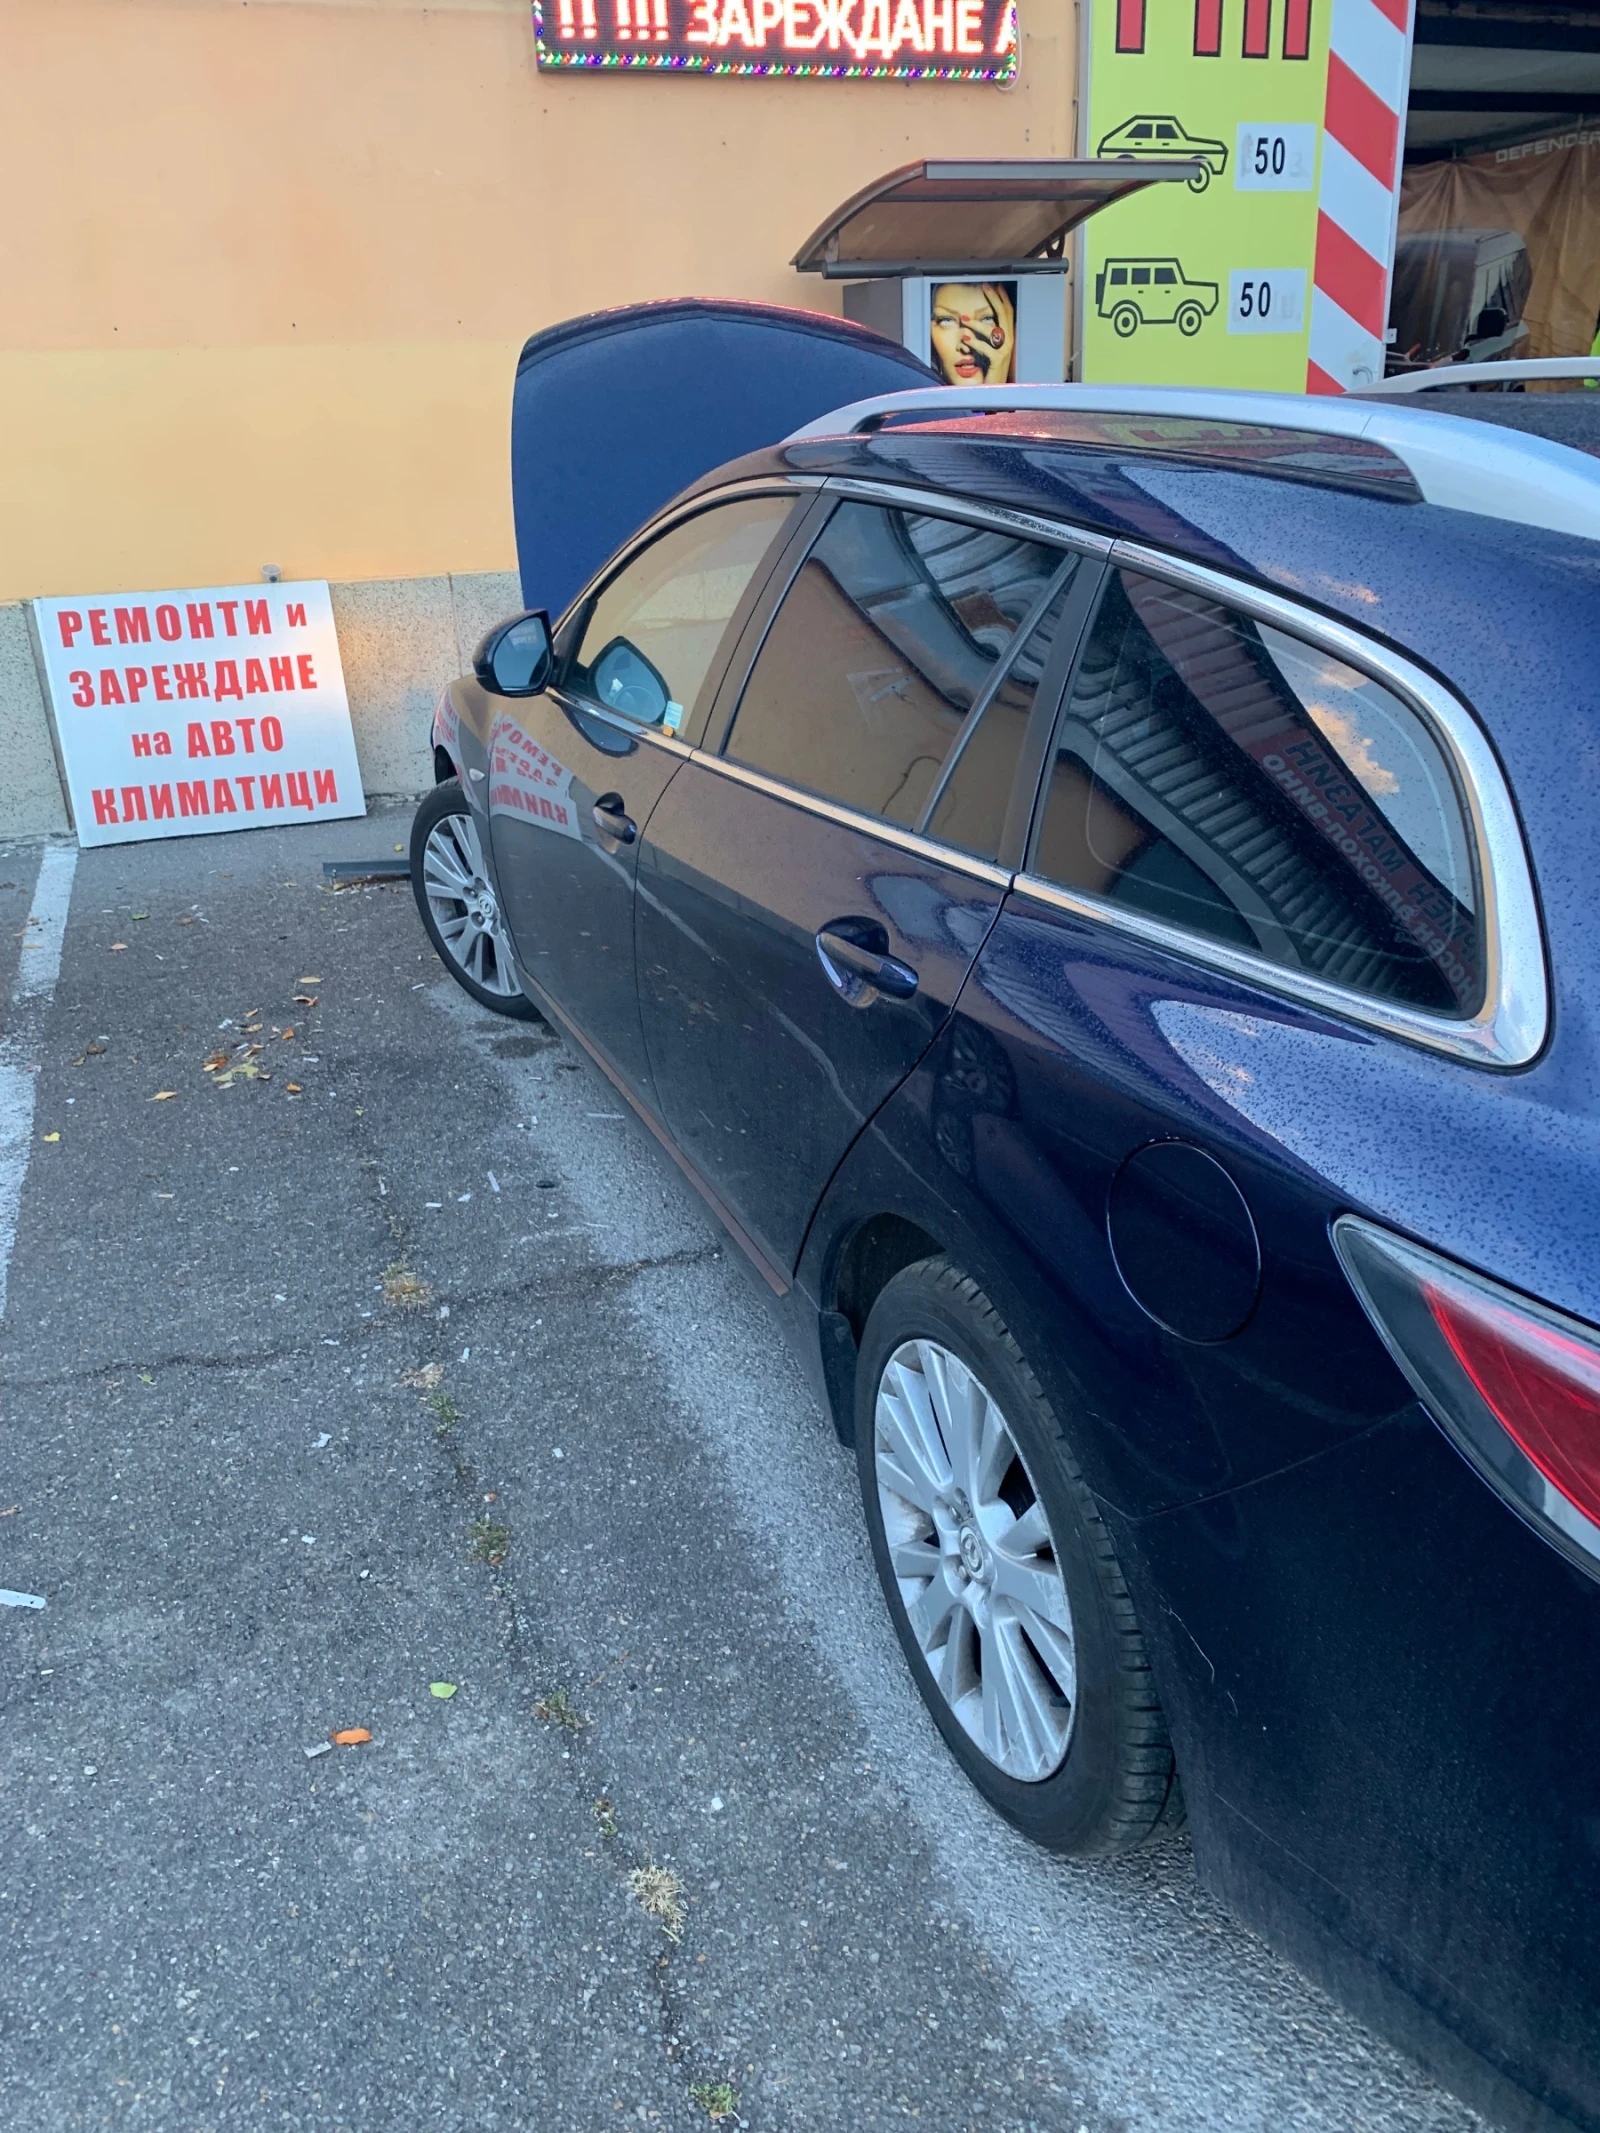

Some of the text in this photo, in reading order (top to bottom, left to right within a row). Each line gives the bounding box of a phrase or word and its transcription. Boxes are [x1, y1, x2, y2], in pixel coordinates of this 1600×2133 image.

[686, 0, 985, 60] ЗАРЕЖДАНЕ
[1254, 136, 1286, 175] 50
[1495, 131, 1600, 164] DEFENDER
[1239, 281, 1271, 318] 50
[56, 598, 308, 648] РЕМОНТИ и
[68, 653, 318, 708] ЗАРЕЖДАНЕ
[131, 715, 285, 759] на АВТО
[91, 768, 339, 825] КЛИМАТИЦИ
